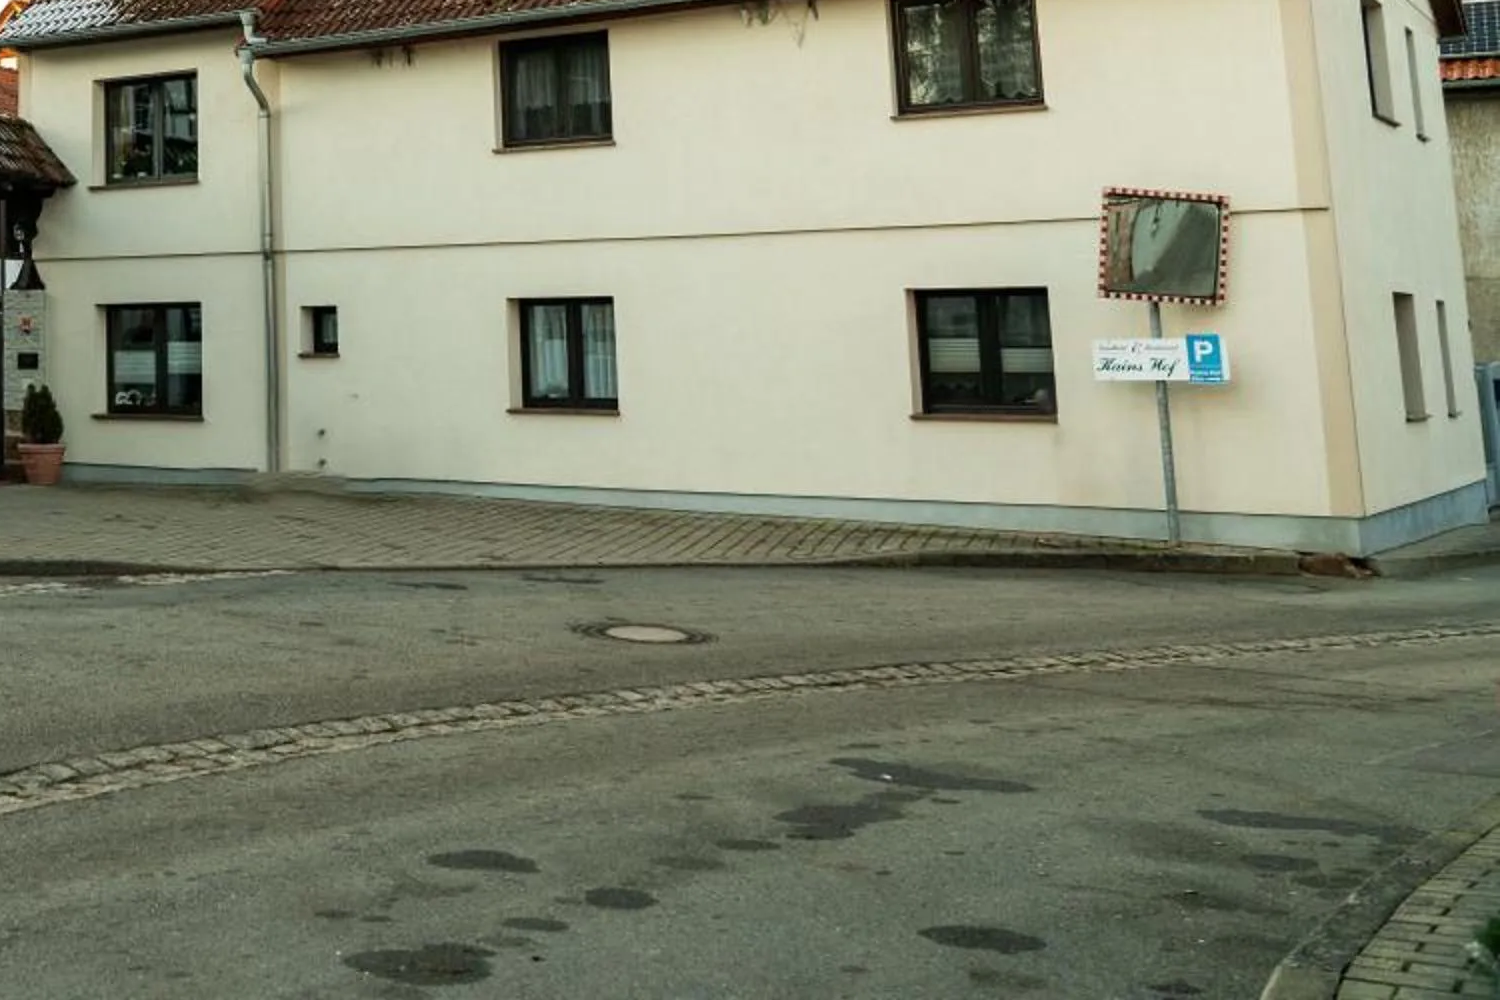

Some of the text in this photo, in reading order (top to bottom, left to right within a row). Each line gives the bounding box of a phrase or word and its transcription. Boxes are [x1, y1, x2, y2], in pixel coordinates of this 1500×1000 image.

[1194, 340, 1213, 363] P
[1097, 357, 1143, 372] Kains
[1149, 357, 1181, 378] Hof
